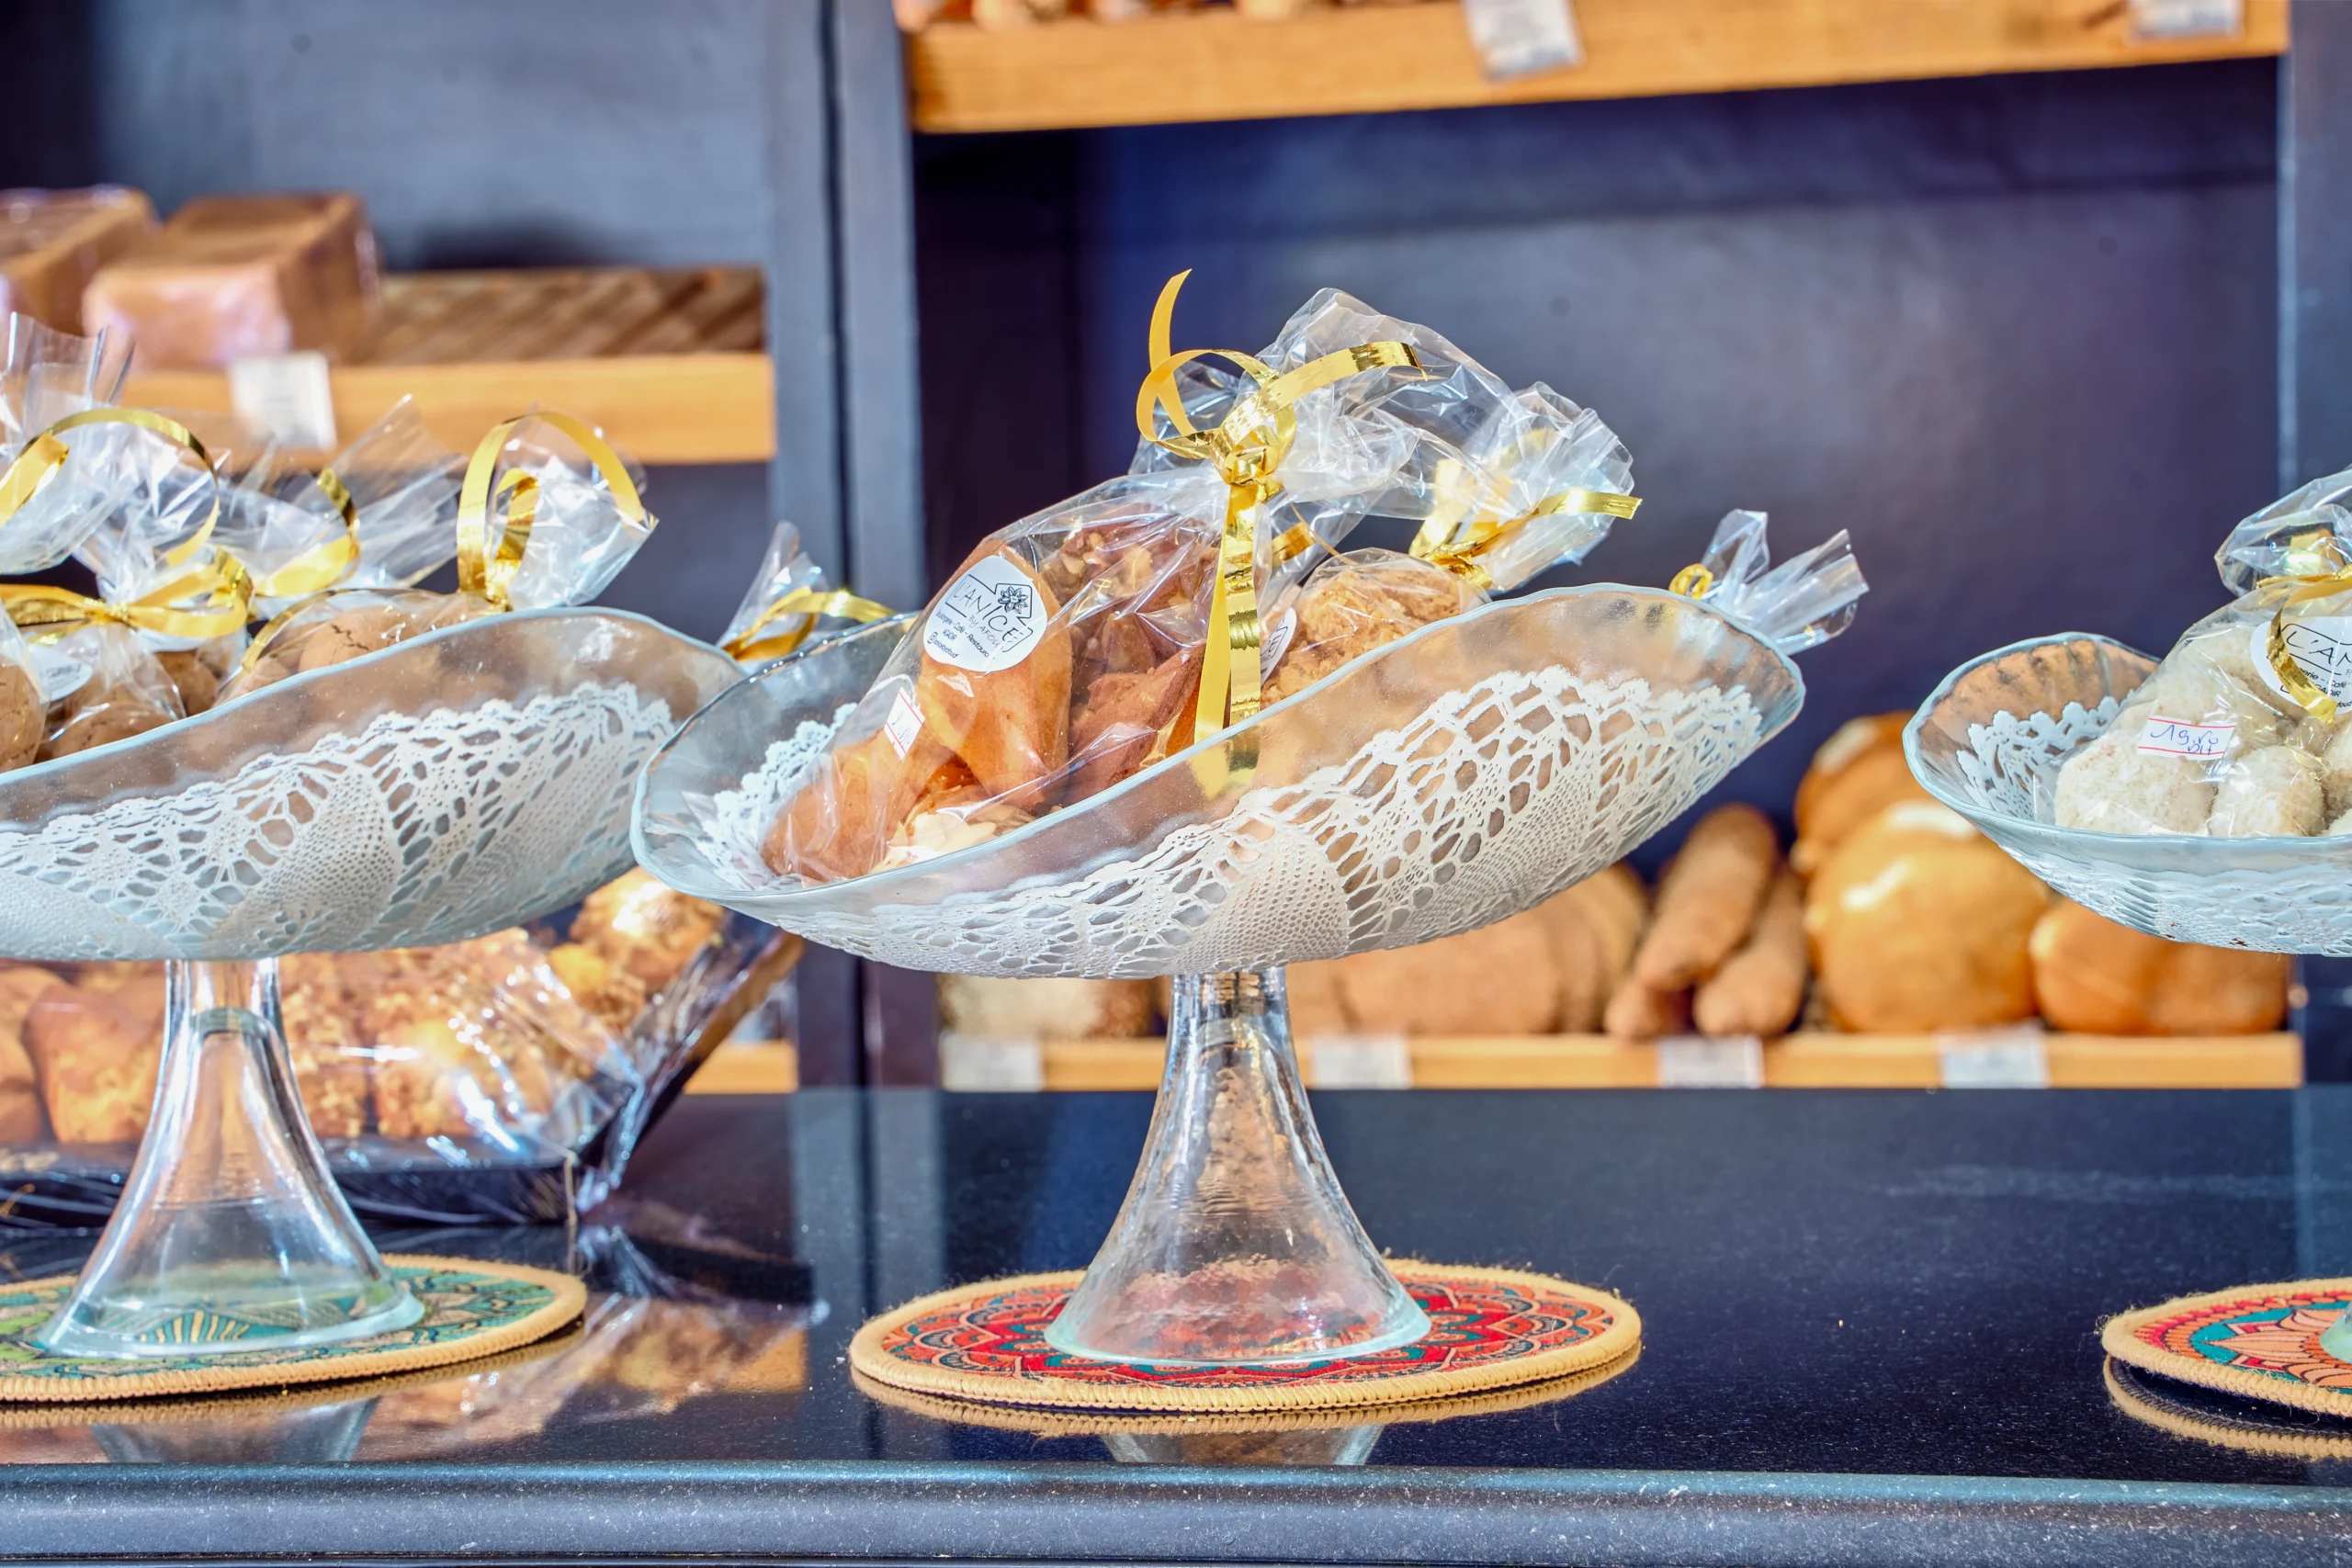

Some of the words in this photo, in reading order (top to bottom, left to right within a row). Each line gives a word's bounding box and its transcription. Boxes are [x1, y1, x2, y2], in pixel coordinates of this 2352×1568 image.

[943, 629, 957, 641] AGADIR
[953, 622, 966, 634] Café
[967, 634, 989, 658] Restaura
